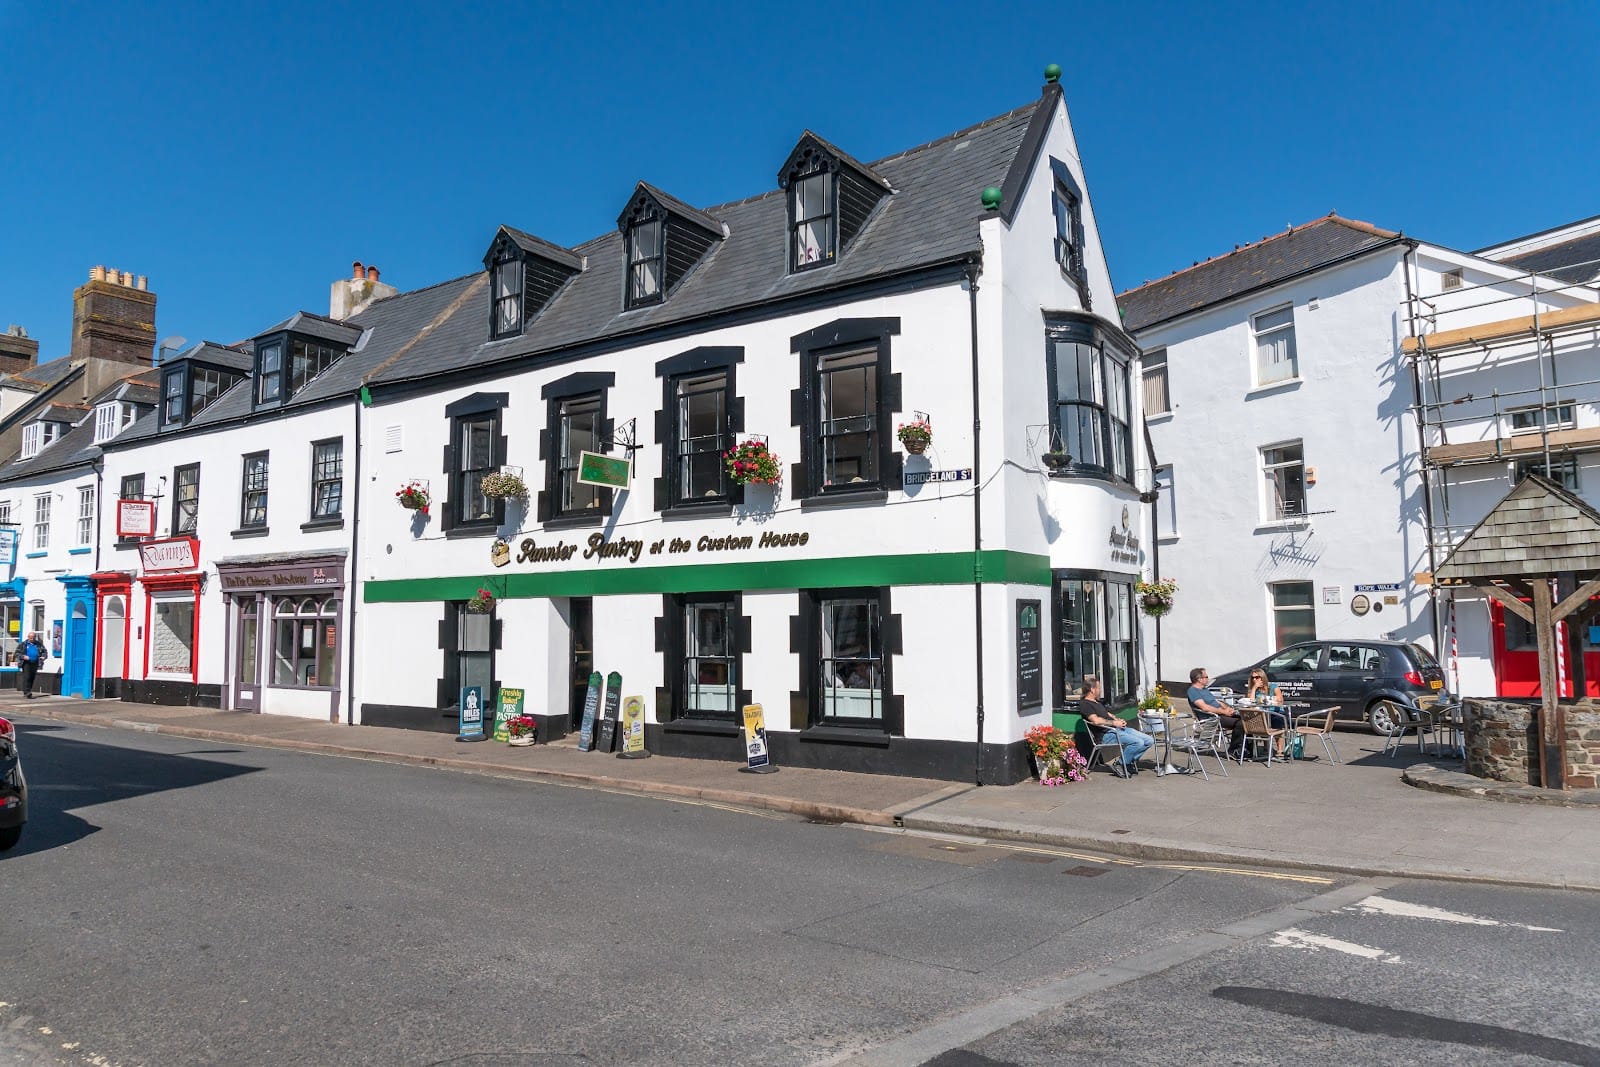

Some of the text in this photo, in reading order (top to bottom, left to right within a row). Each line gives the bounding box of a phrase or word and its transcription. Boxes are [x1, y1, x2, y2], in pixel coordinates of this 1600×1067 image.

[906, 471, 957, 484] BRIDGELAND
[516, 531, 809, 564] Pannier Pantry at the Custom House
[501, 688, 522, 699] Freshly
[502, 704, 517, 713] PIES
